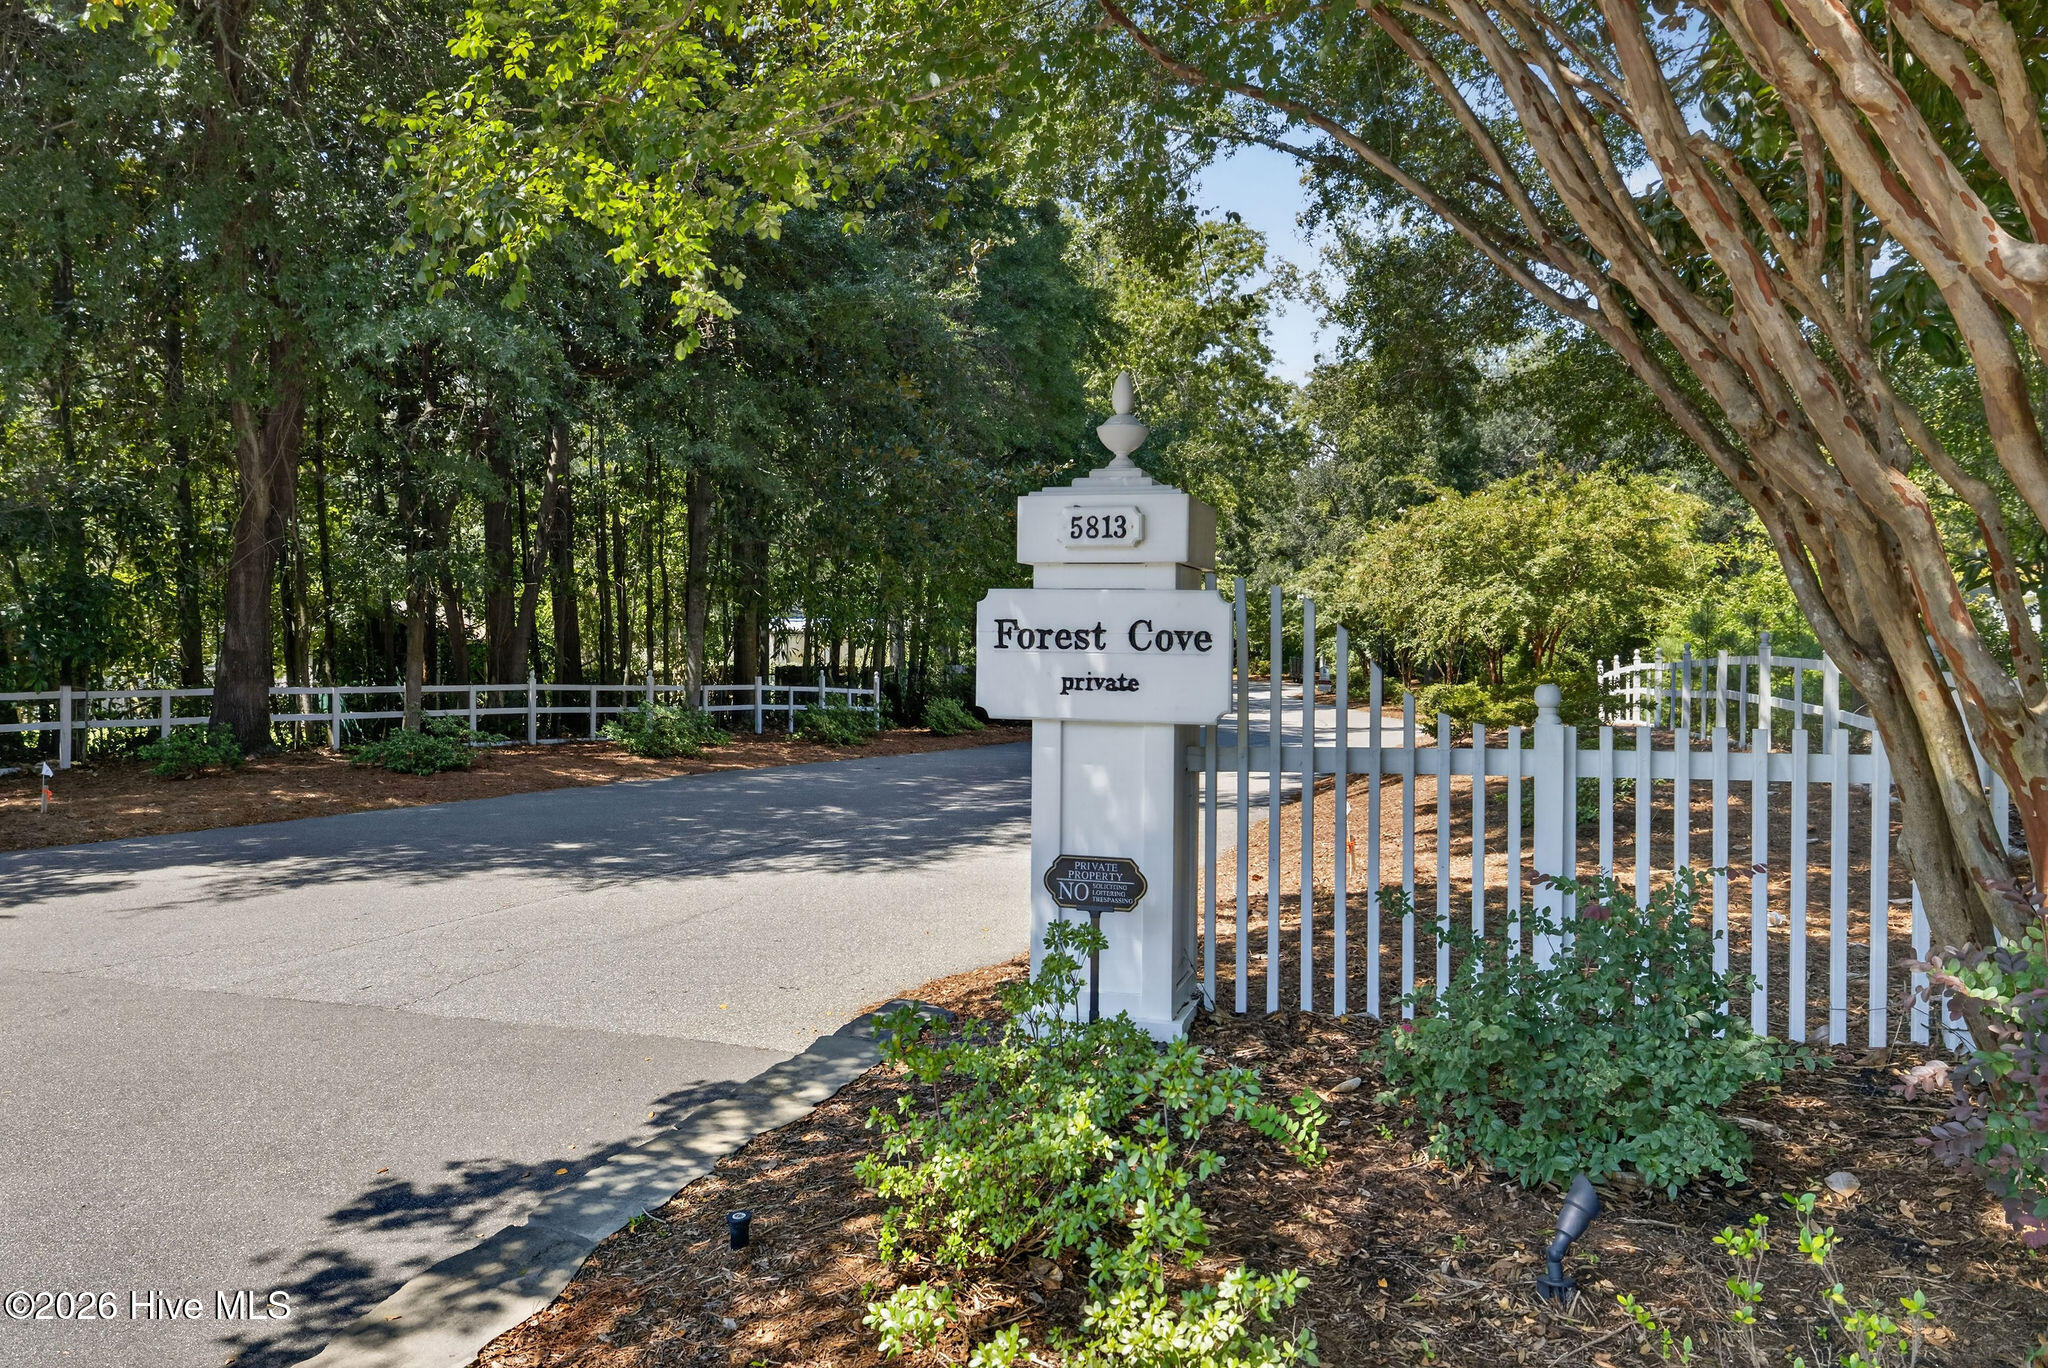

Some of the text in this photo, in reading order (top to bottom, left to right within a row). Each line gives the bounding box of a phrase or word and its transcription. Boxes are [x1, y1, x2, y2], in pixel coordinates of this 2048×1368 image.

[1070, 515, 1127, 539] 5813
[993, 618, 1213, 652] Forest Cove
[1060, 672, 1140, 695] private
[1068, 870, 1123, 882] PROPERTY
[1074, 861, 1118, 872] PRIVATE
[1058, 881, 1089, 901] NO
